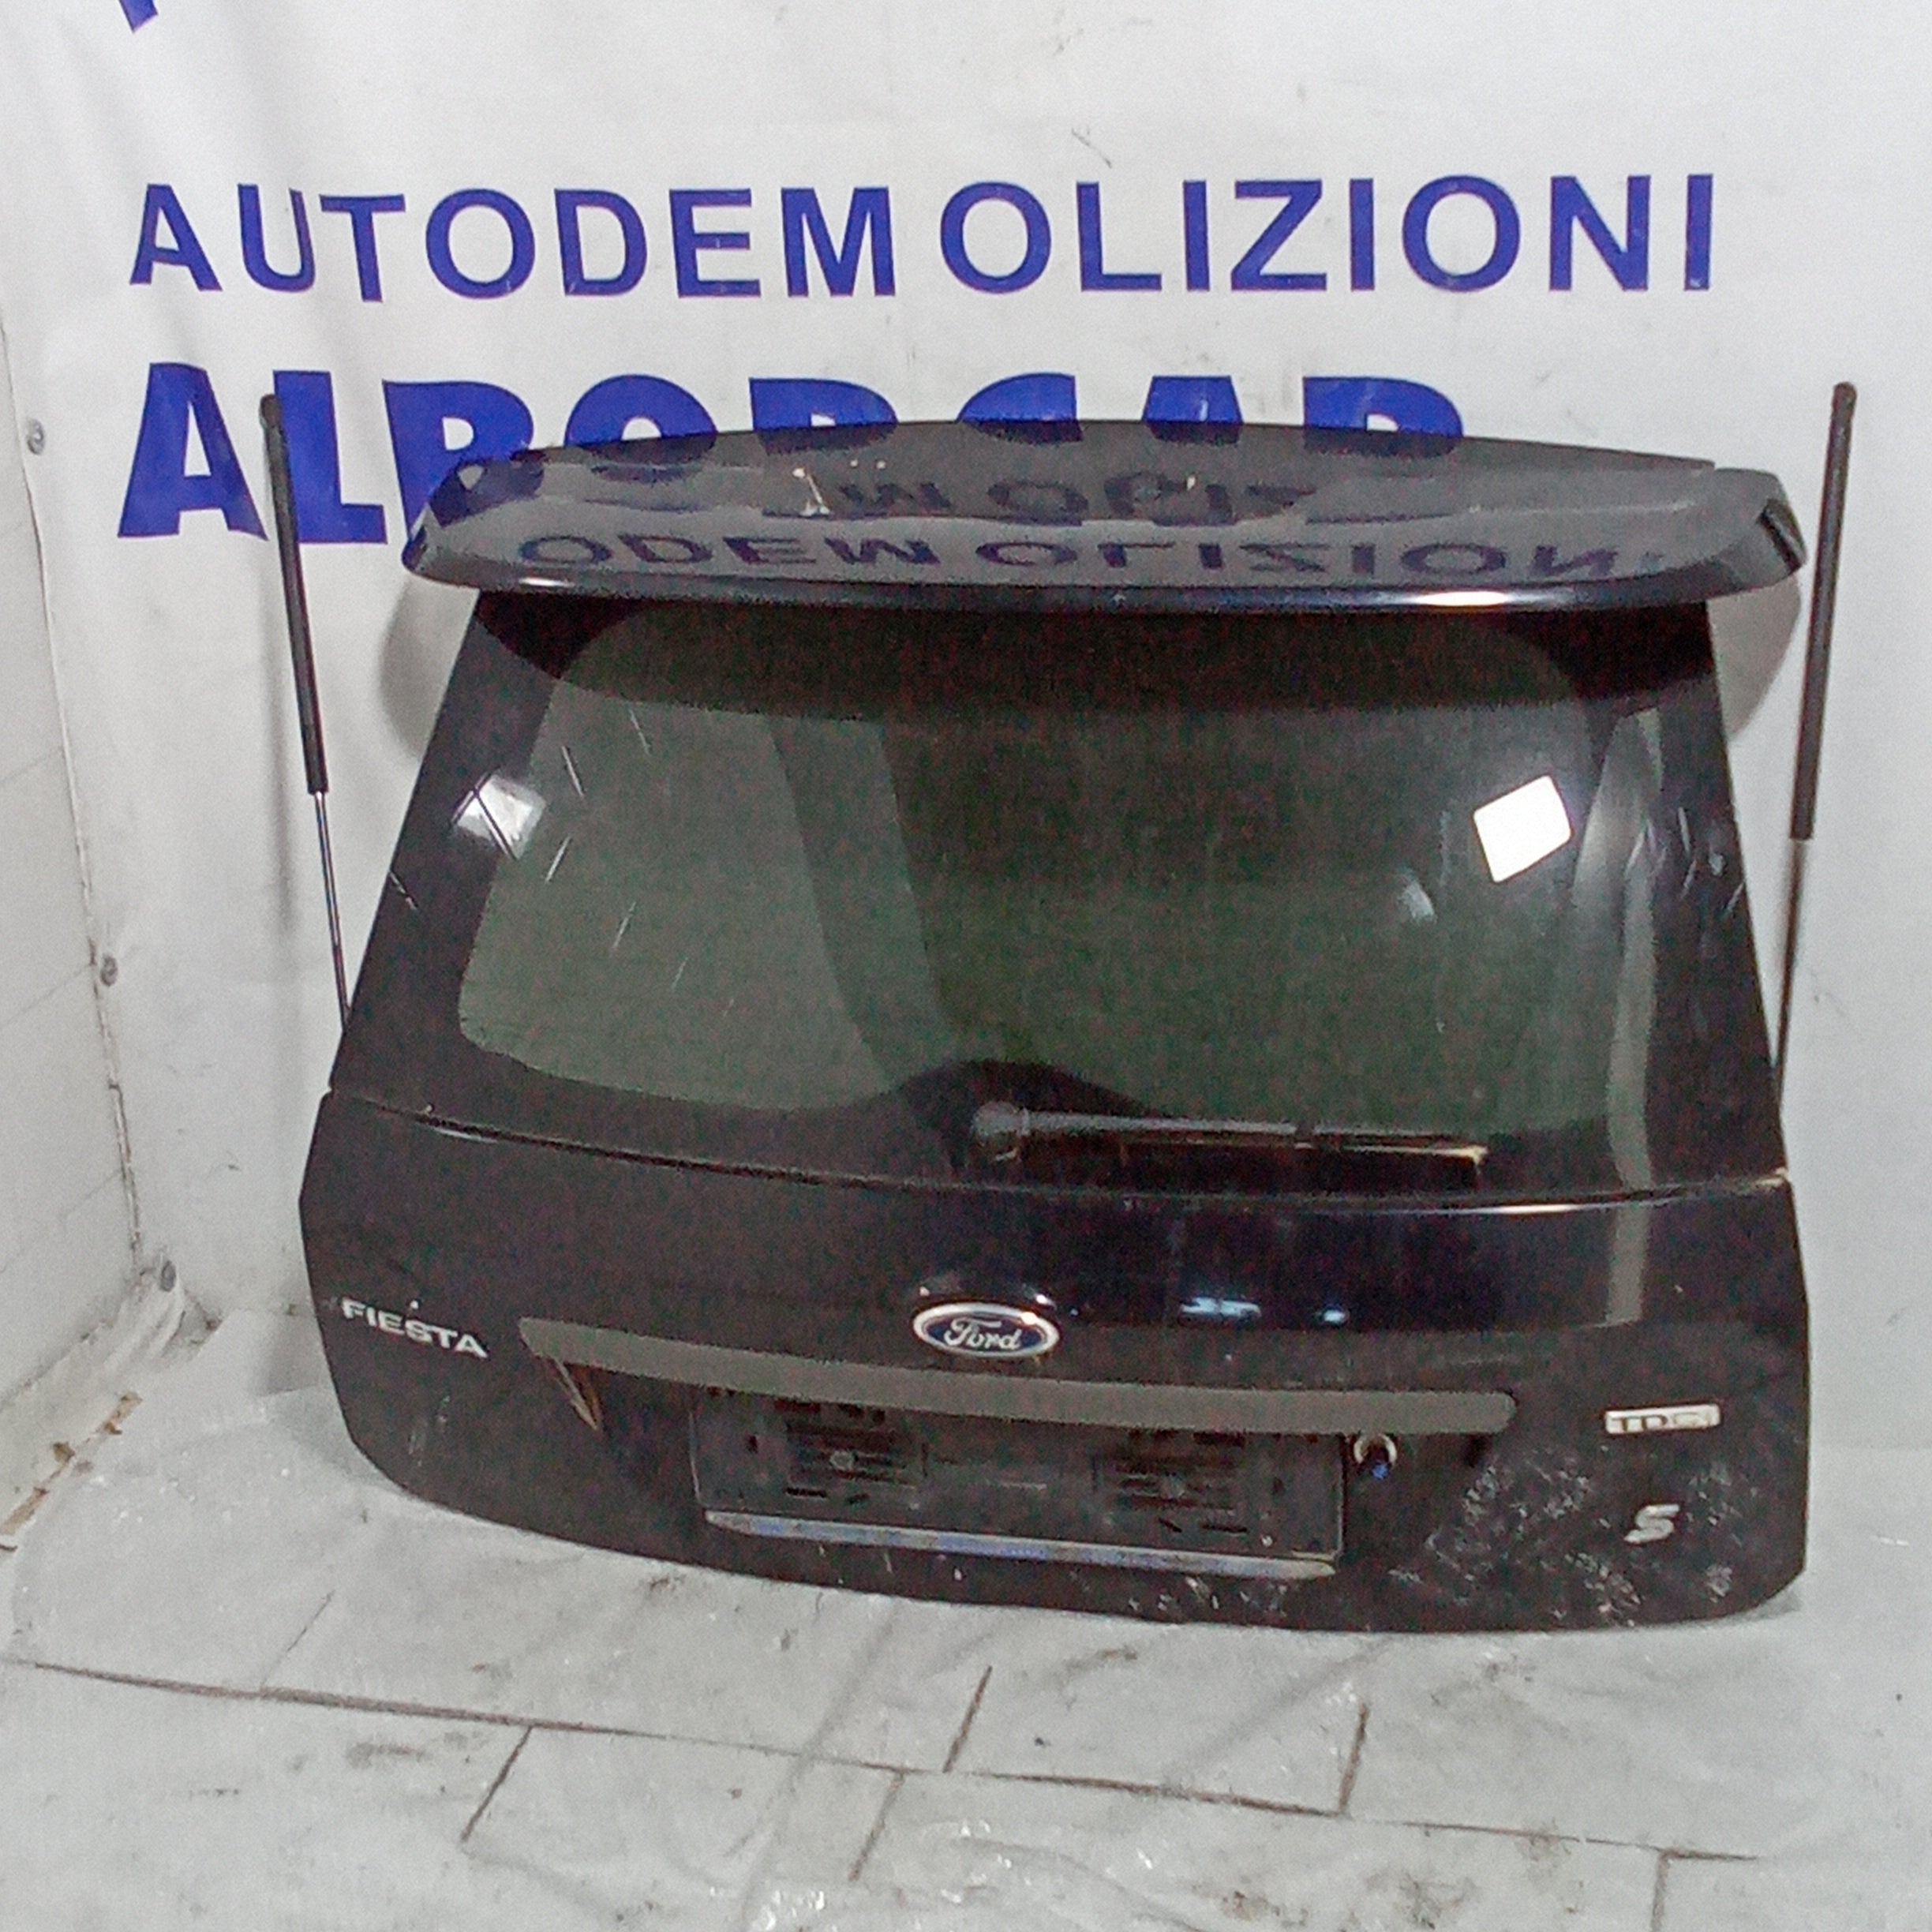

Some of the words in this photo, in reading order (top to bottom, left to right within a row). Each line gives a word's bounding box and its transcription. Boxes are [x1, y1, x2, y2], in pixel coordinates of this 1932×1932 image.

[342, 1297, 488, 1358] FIESTA
[944, 1317, 1023, 1351] Ford
[1623, 1503, 1680, 1544] S
